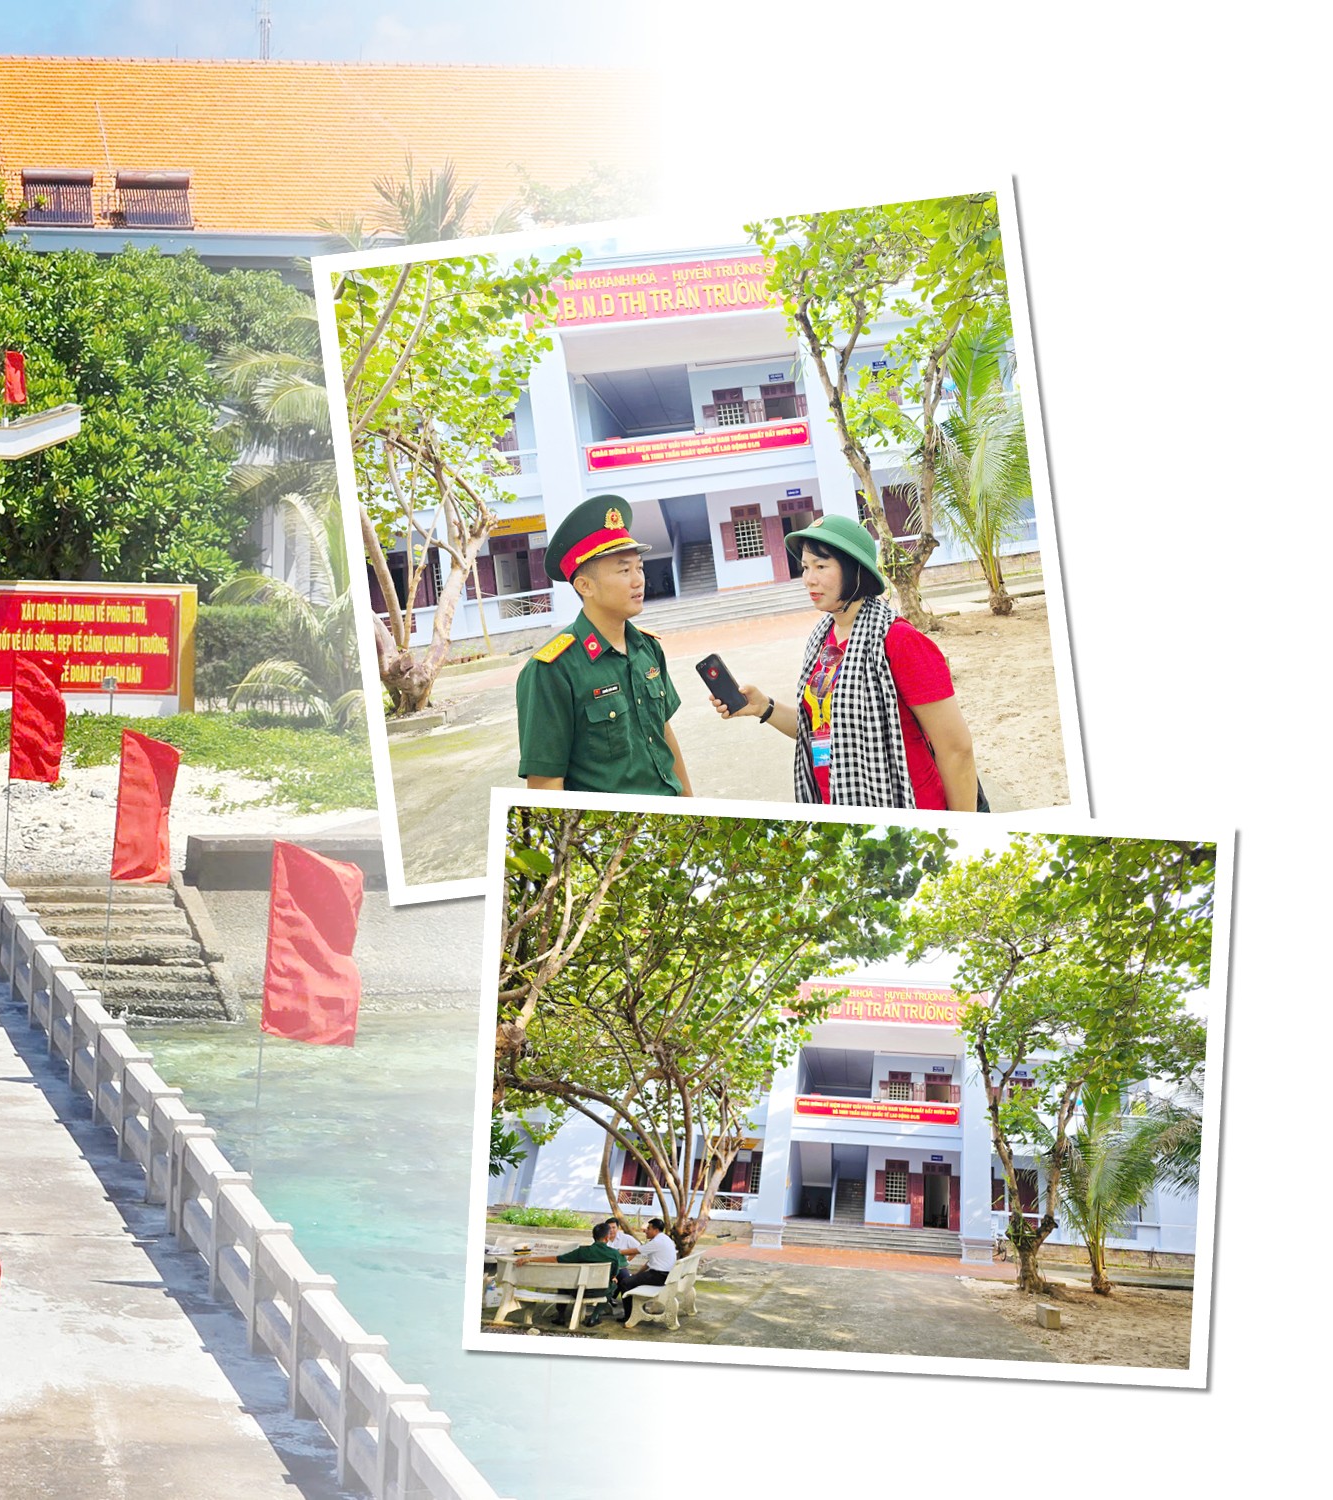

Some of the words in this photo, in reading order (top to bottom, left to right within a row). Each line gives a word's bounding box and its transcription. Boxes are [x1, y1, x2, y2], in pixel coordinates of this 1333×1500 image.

[589, 272, 631, 289] KHÁNH
[632, 269, 658, 287] HOÀ
[672, 264, 712, 283] HUYỆN
[714, 261, 762, 279] TRƯỜNG
[763, 261, 775, 275] S
[550, 294, 616, 321] .B.N.D
[617, 290, 648, 319] THỊ
[21, 599, 36, 621] XÂY
[36, 602, 57, 625] DỰNG
[73, 604, 96, 626] MẠNH
[22, 628, 34, 651] LỐI
[34, 627, 57, 654] SỐNG,
[57, 634, 73, 656] ĐẸP
[83, 629, 104, 653] CẢNH
[104, 634, 124, 655] QUAN
[124, 632, 140, 654] MÔI
[91, 660, 105, 683] KẾT
[126, 662, 143, 684] DÂN
[845, 1000, 863, 1020] THỊ
[901, 1001, 954, 1021] TRƯỜNG
